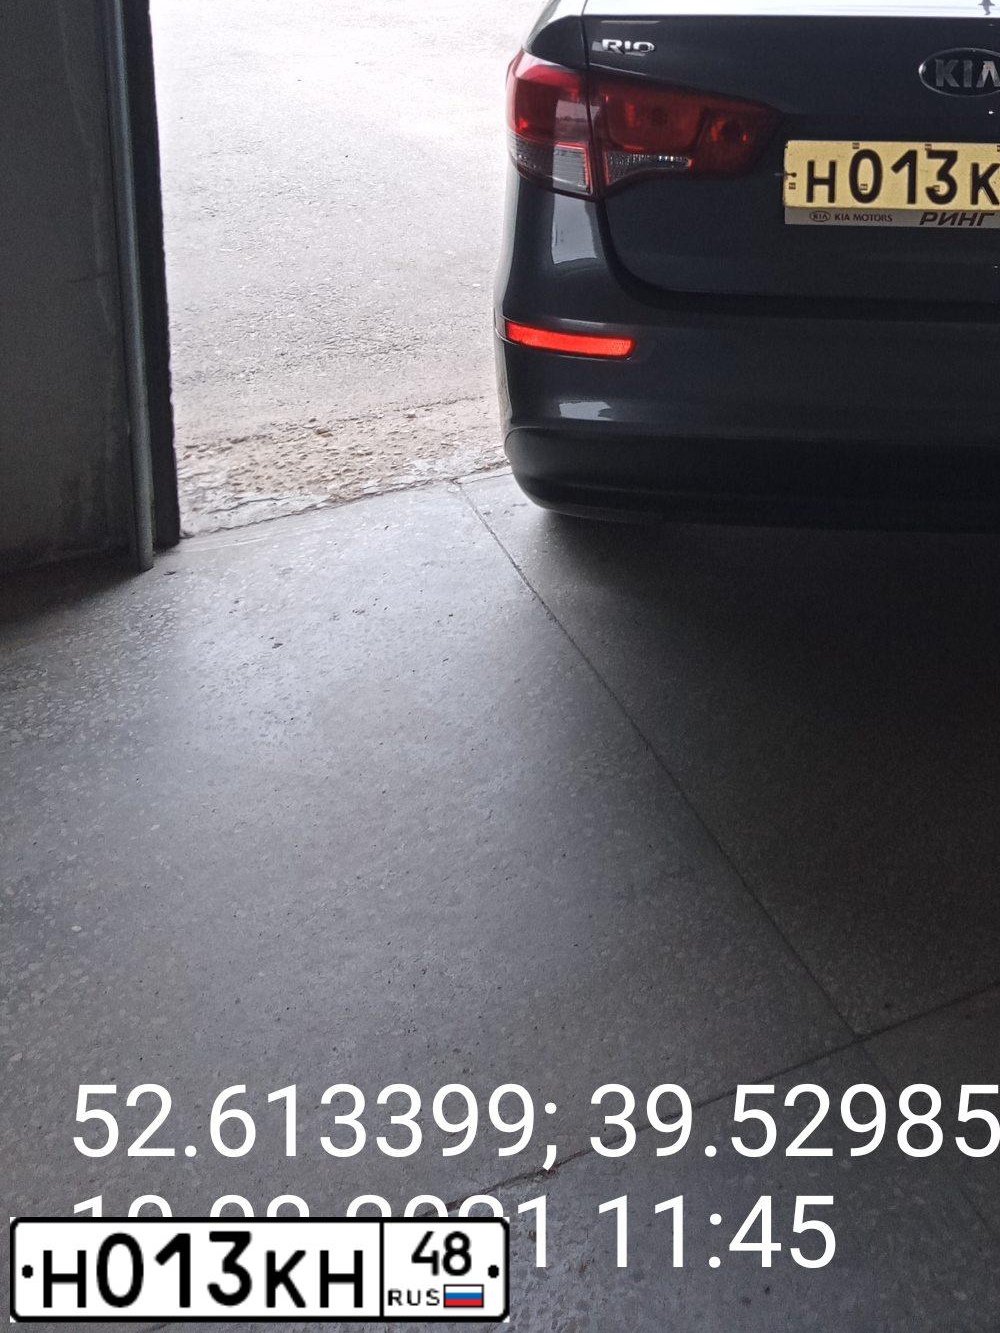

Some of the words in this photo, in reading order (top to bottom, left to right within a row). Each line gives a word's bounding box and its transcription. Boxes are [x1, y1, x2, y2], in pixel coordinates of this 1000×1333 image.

[601, 38, 655, 54] RIO
[834, 213, 850, 221] KIA
[852, 213, 893, 222] MOTORS
[919, 212, 995, 226] РИНГ
